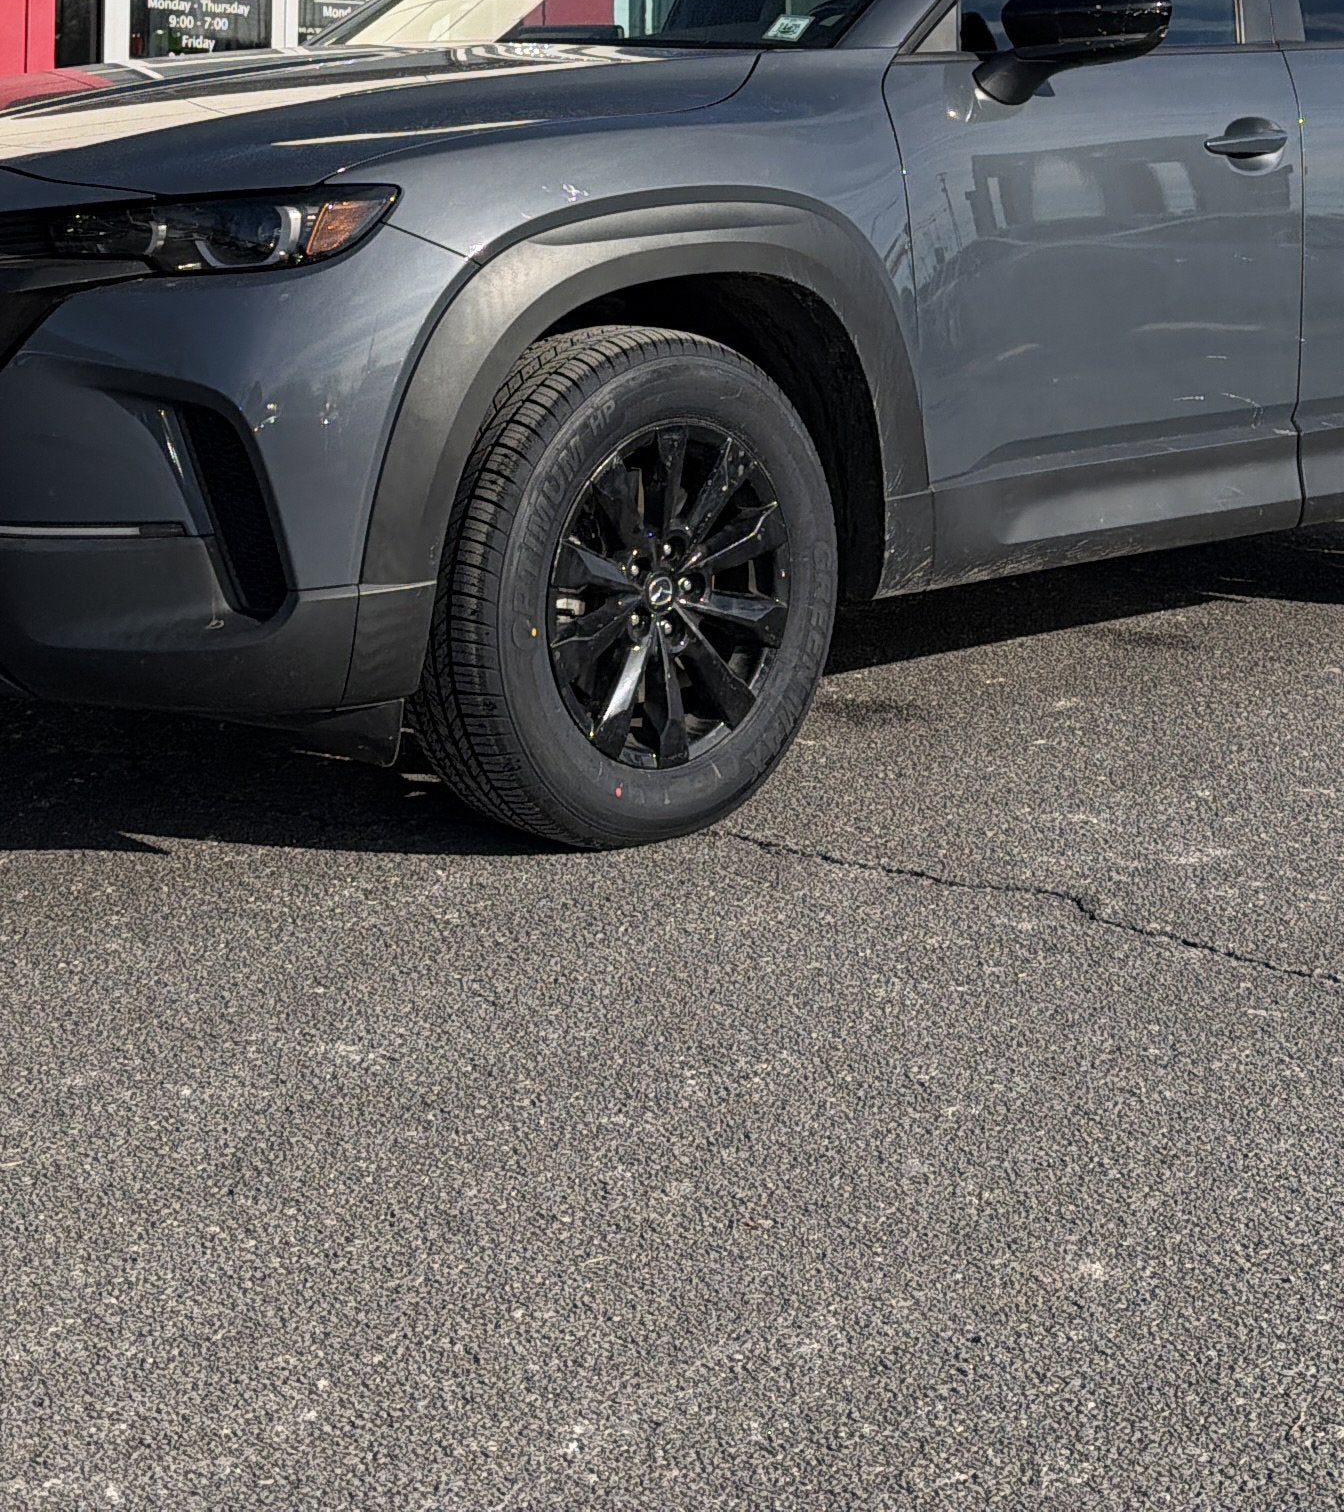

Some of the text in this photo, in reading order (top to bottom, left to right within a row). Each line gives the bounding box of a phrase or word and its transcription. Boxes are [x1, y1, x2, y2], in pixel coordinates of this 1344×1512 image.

[200, 0, 251, 17] Thursday
[168, 15, 194, 28] 9:00
[204, 16, 229, 31] 7:00
[181, 35, 216, 54] Friday
[588, 399, 617, 437] HP
